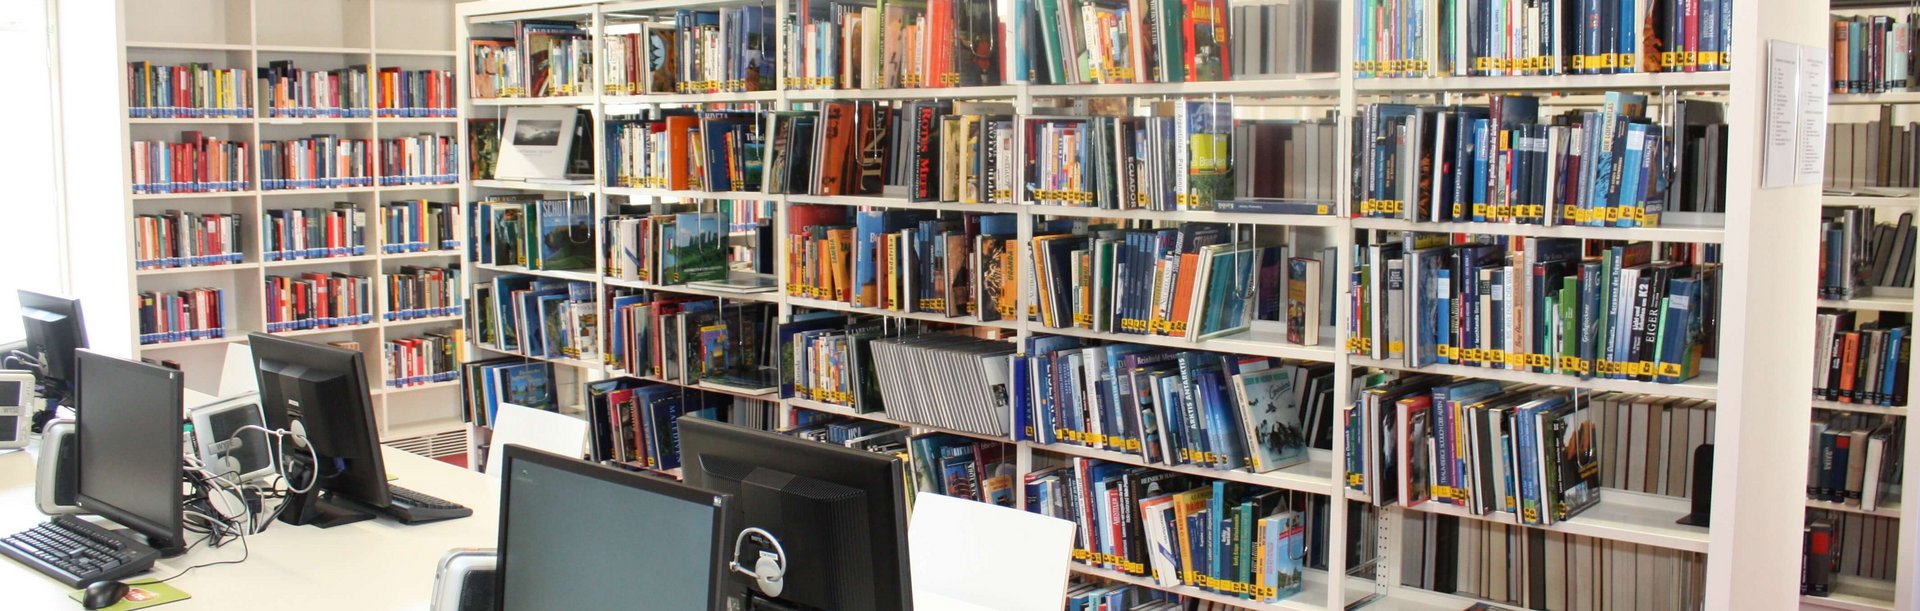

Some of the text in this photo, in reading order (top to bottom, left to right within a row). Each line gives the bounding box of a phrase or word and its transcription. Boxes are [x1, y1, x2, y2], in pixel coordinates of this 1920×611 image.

[1604, 102, 1614, 139] LOIPENATLAS
[1128, 156, 1136, 208] ECUADOR
[1612, 255, 1620, 275] Träume
[1638, 283, 1648, 297] K2
[1582, 304, 1590, 342] Großglockner
[1638, 308, 1646, 330] Schatten
[1647, 309, 1658, 343] EIGER
[1179, 358, 1197, 430] ARKTIS ANTARKTIS
[669, 405, 680, 463] MALEDIVEN
[848, 427, 861, 439] USA
